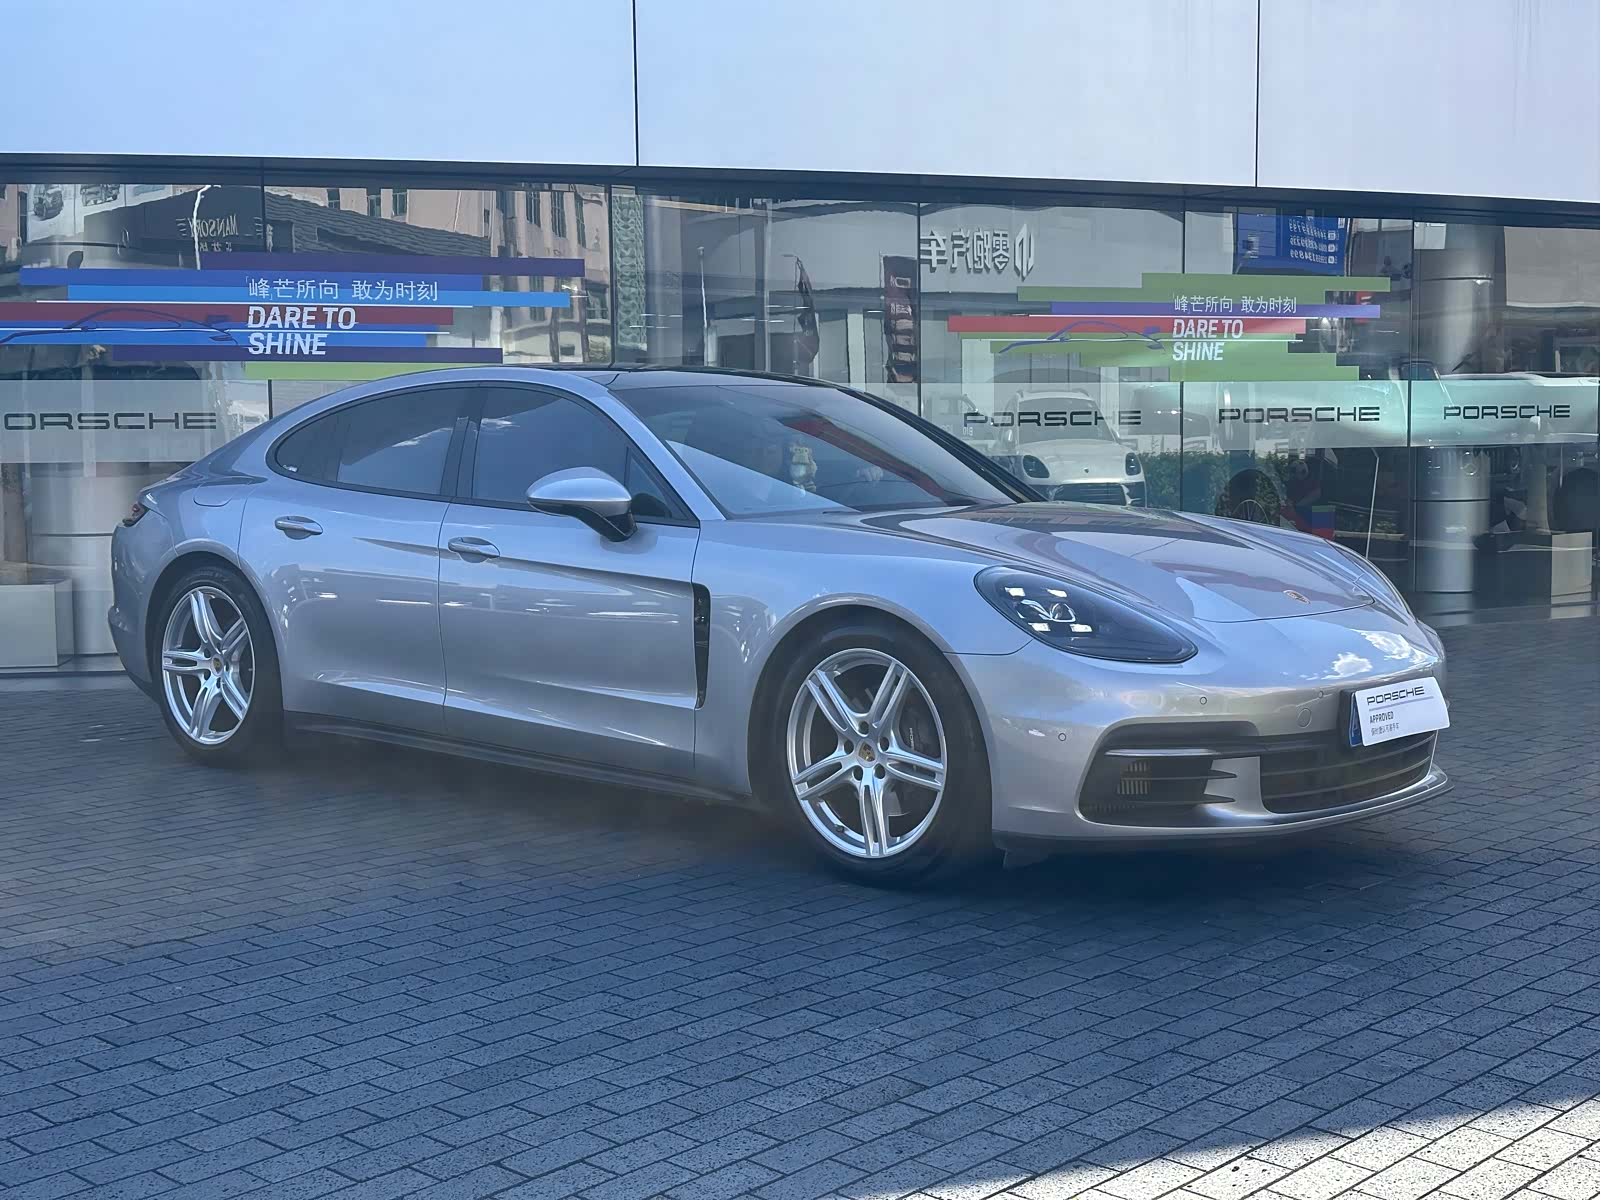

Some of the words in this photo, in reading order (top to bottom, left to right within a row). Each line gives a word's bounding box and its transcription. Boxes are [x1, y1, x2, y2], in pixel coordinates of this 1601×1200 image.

[351, 279, 438, 301] 敢为时刻
[1241, 295, 1297, 314] 敢为时刻
[247, 305, 316, 329] DARE
[322, 307, 357, 330] TO
[1172, 319, 1218, 339] DARE
[1222, 319, 1244, 339] TO
[247, 332, 329, 356] SHINE
[1172, 341, 1225, 361] SHINE
[963, 410, 1142, 427] PORSCHE
[1218, 406, 1380, 424] PORSCHE
[1443, 404, 1571, 420] PORSCHE
[1366, 686, 1425, 706] PORSCHE
[1369, 711, 1394, 724] APPROVED
